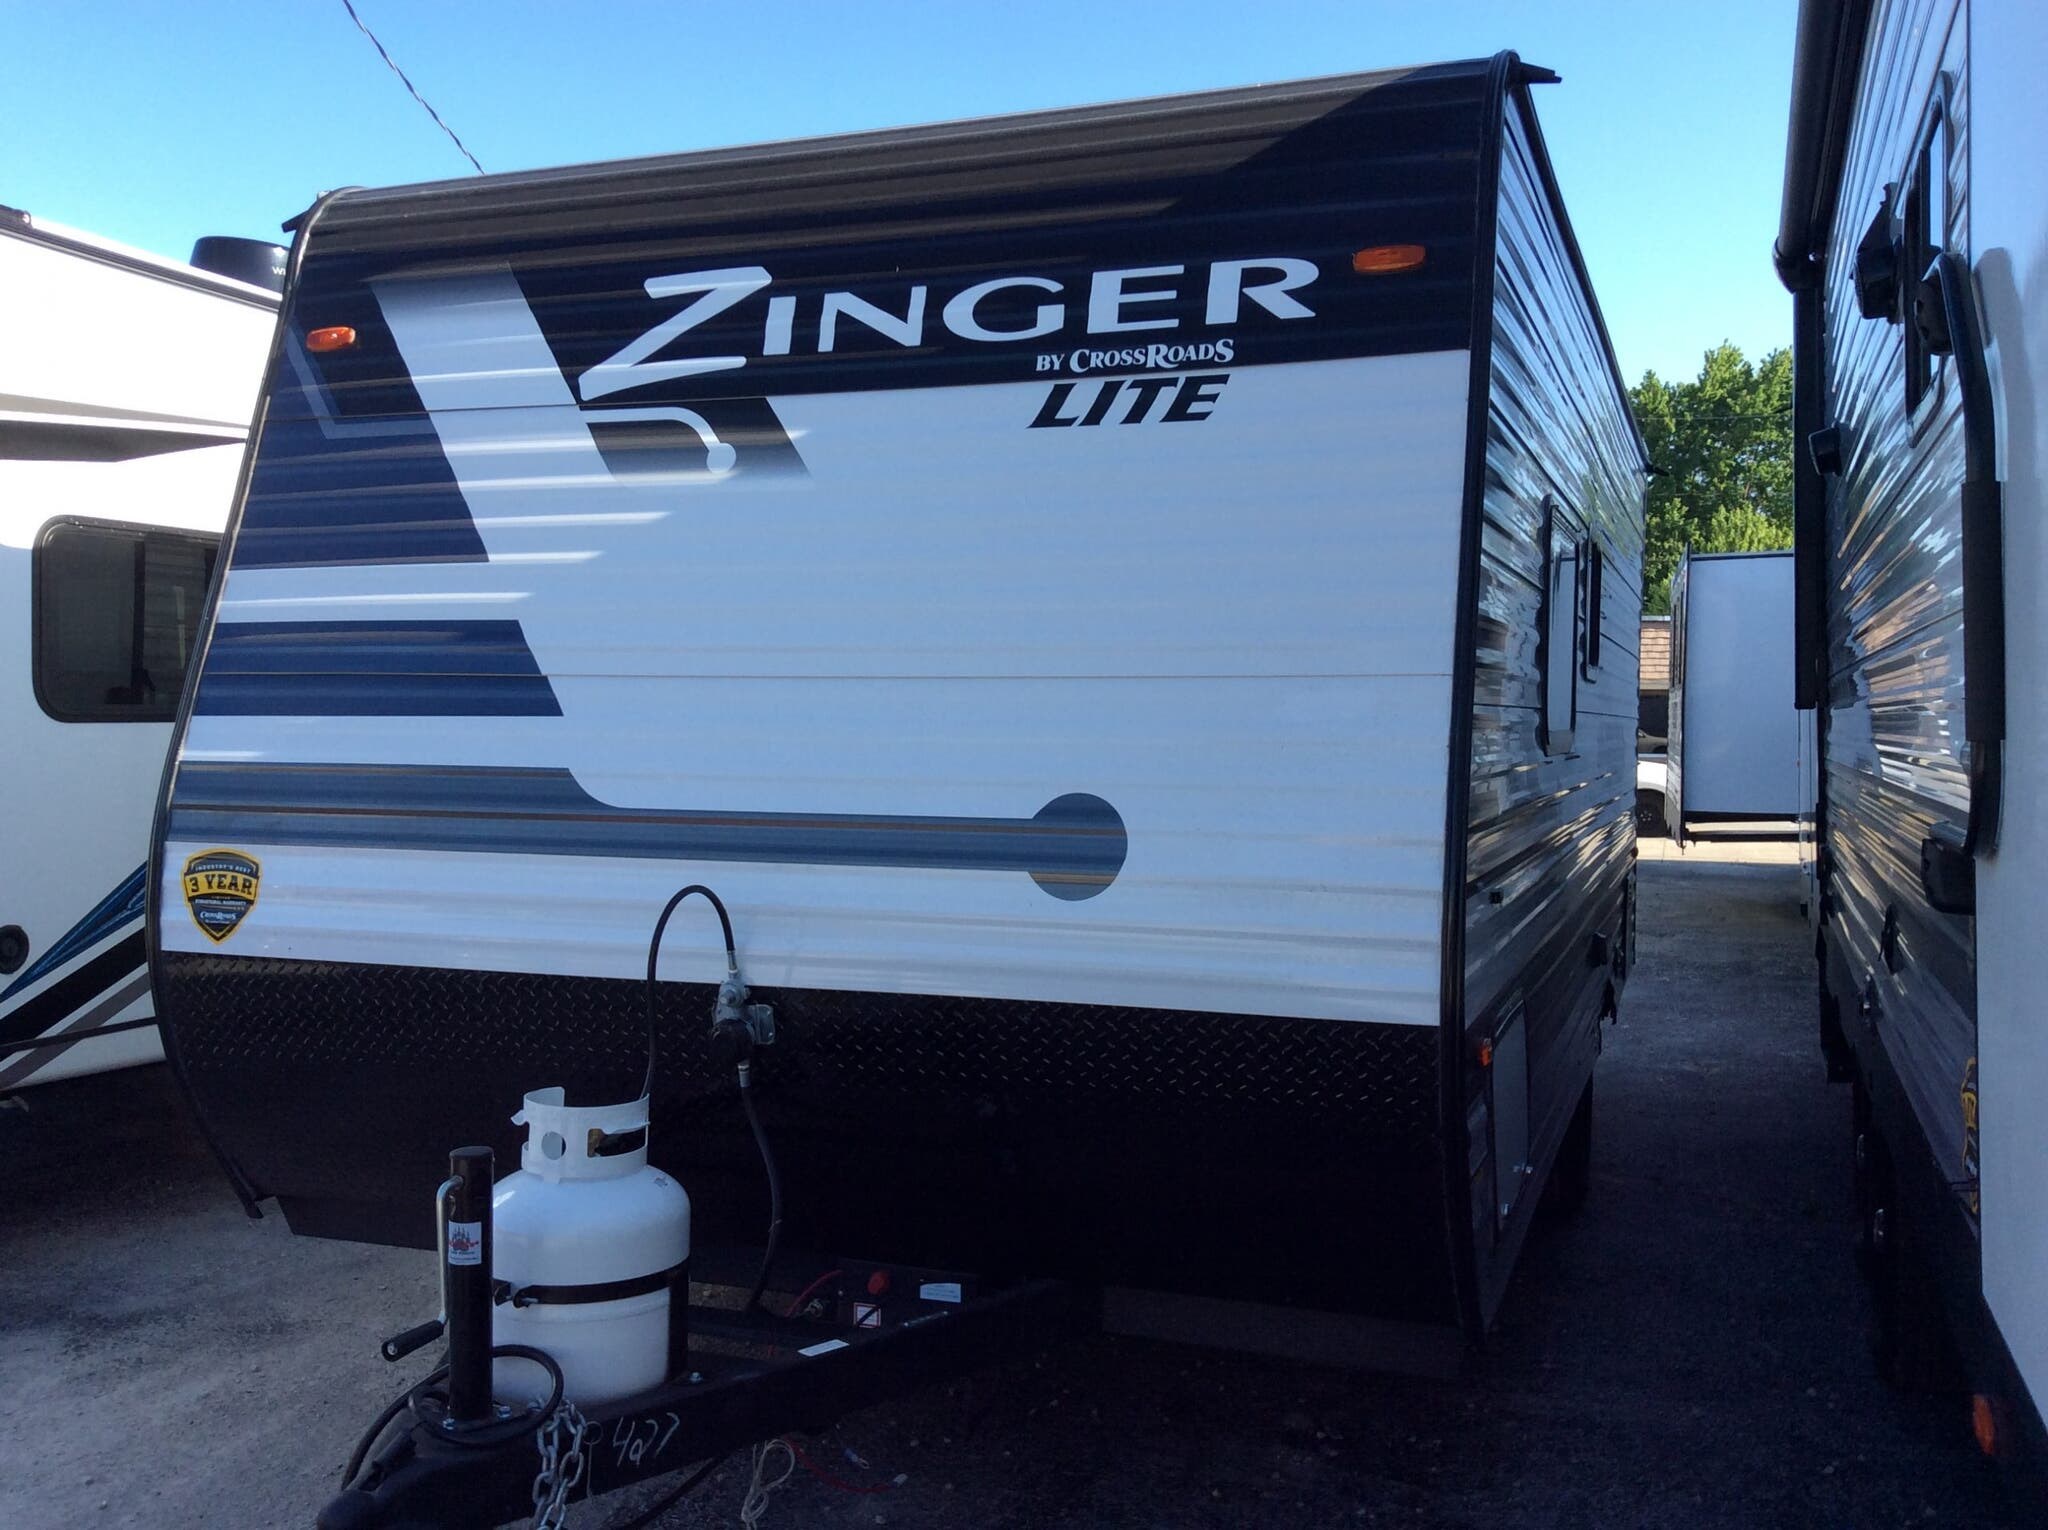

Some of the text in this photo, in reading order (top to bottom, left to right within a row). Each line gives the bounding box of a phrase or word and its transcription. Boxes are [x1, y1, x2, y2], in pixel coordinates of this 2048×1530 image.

[579, 257, 1319, 401] ZINGER
[1035, 353, 1065, 372] BY
[1026, 373, 1232, 429] LITE
[189, 873, 253, 896] 3 YEAR
